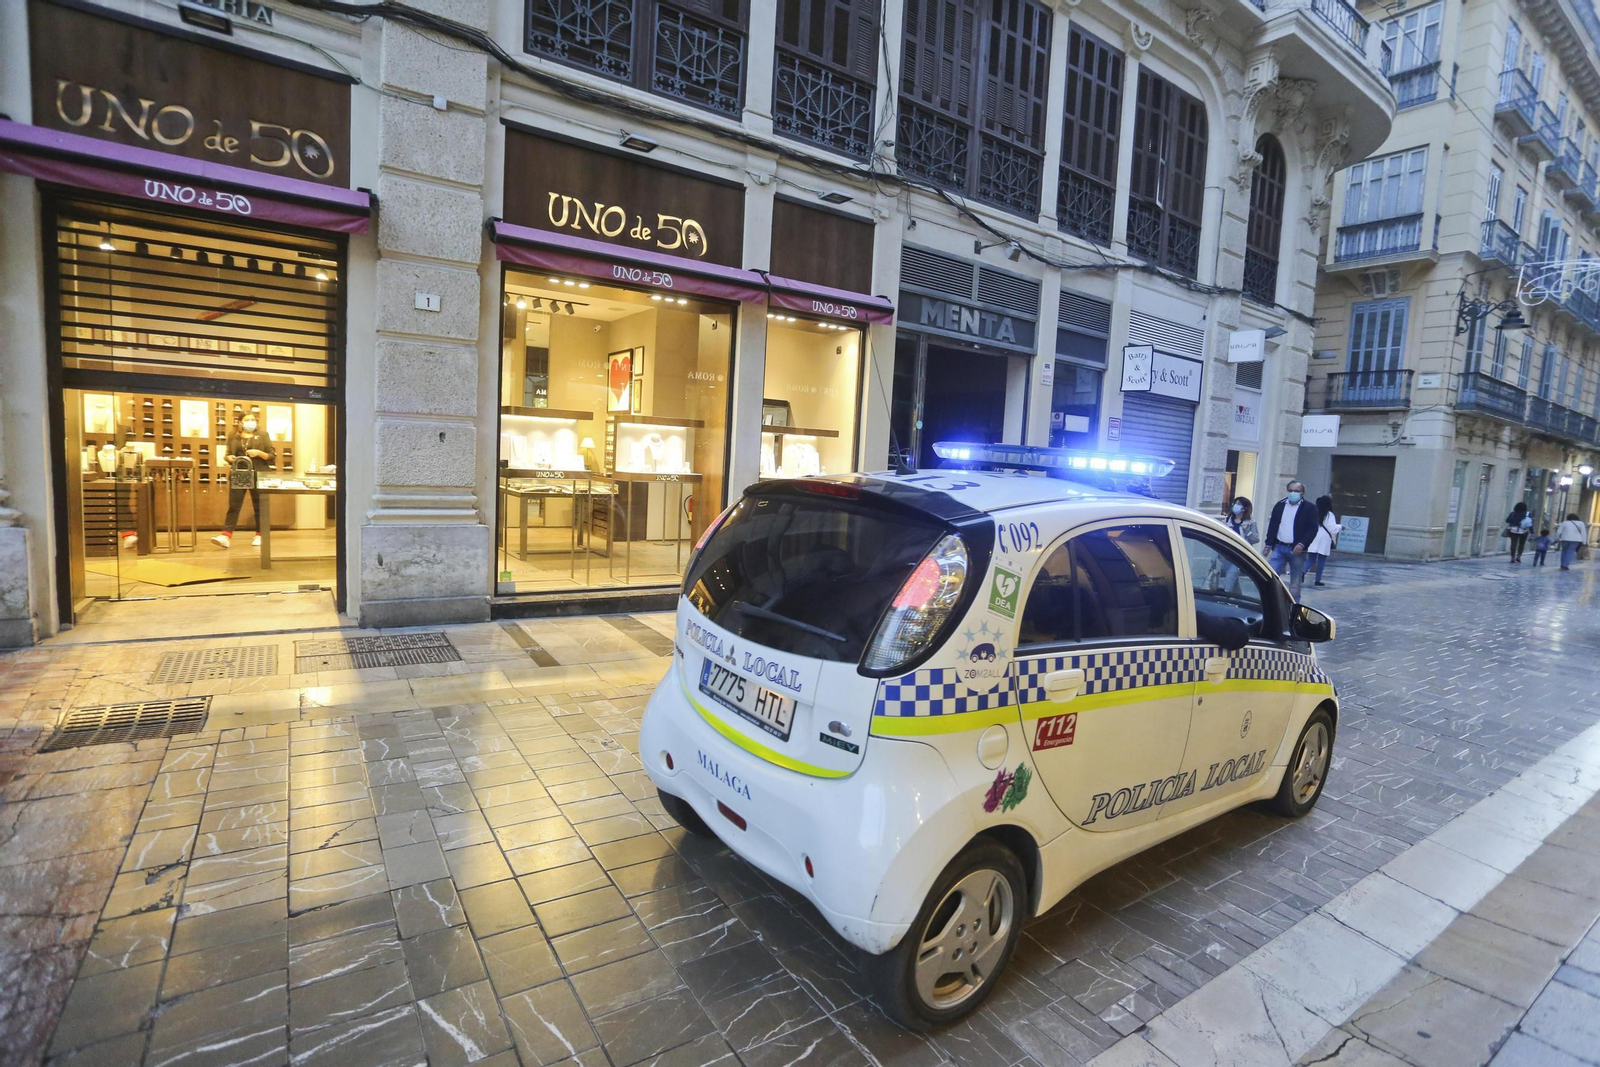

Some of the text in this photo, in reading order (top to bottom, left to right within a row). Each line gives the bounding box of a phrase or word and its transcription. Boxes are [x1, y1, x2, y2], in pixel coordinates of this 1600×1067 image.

[56, 79, 335, 179] UNO de 50
[144, 179, 252, 215] UNO de 50
[548, 191, 708, 257] UNO de 50
[613, 265, 674, 288] UNO de 50
[426, 297, 430, 308] 1
[812, 300, 833, 314] UNO
[841, 305, 857, 319] 50
[919, 297, 1016, 343] MENTA
[1127, 352, 1148, 361] Barry
[1160, 368, 1167, 382] &
[1009, 521, 1043, 553] 092
[995, 597, 1011, 610] DEA
[686, 619, 803, 692] POLICIA LOCAL
[710, 663, 747, 703] 7775
[754, 687, 785, 728] HTL
[1047, 713, 1076, 737] 112
[697, 749, 751, 801] MALAGA
[1081, 769, 1197, 826] POLICIA
[1200, 749, 1267, 791] LOCAL
